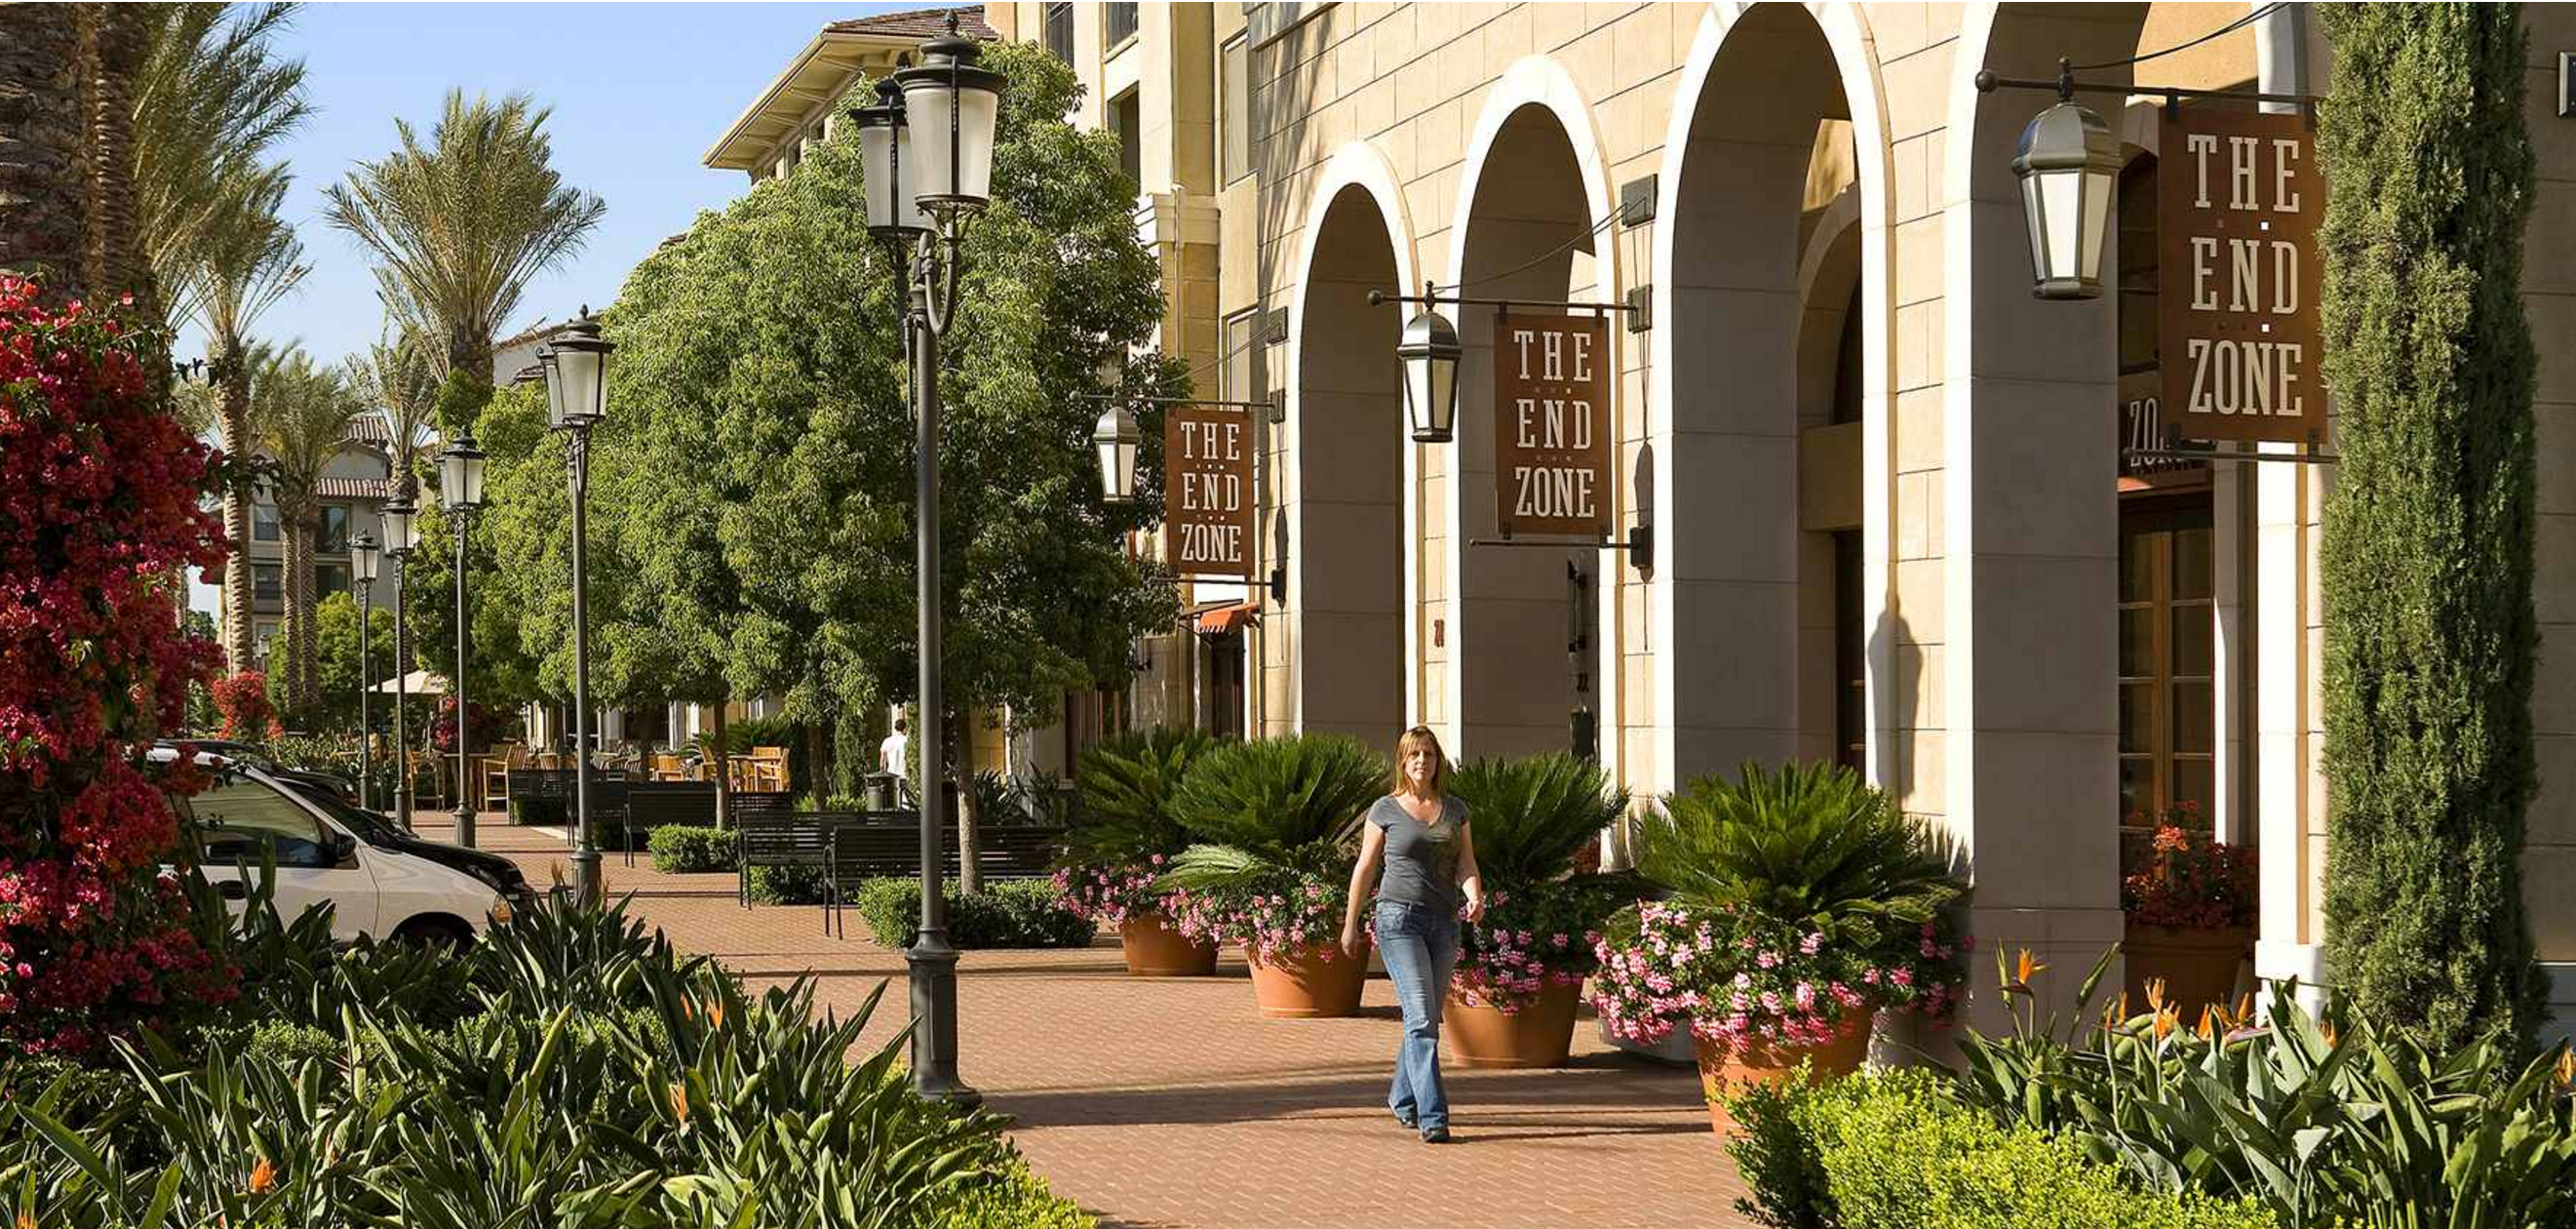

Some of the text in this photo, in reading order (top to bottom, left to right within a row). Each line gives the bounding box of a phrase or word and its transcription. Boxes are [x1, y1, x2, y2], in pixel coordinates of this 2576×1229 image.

[2187, 134, 2300, 214] THE
[2190, 236, 2298, 314] END
[1513, 330, 1592, 382] THE
[2188, 338, 2303, 416] ZONE
[1180, 421, 1240, 461] THE
[1516, 398, 1591, 450] END
[1182, 472, 1239, 511] END
[1515, 466, 1595, 518] ZONE
[1181, 523, 1242, 563] ZONE
